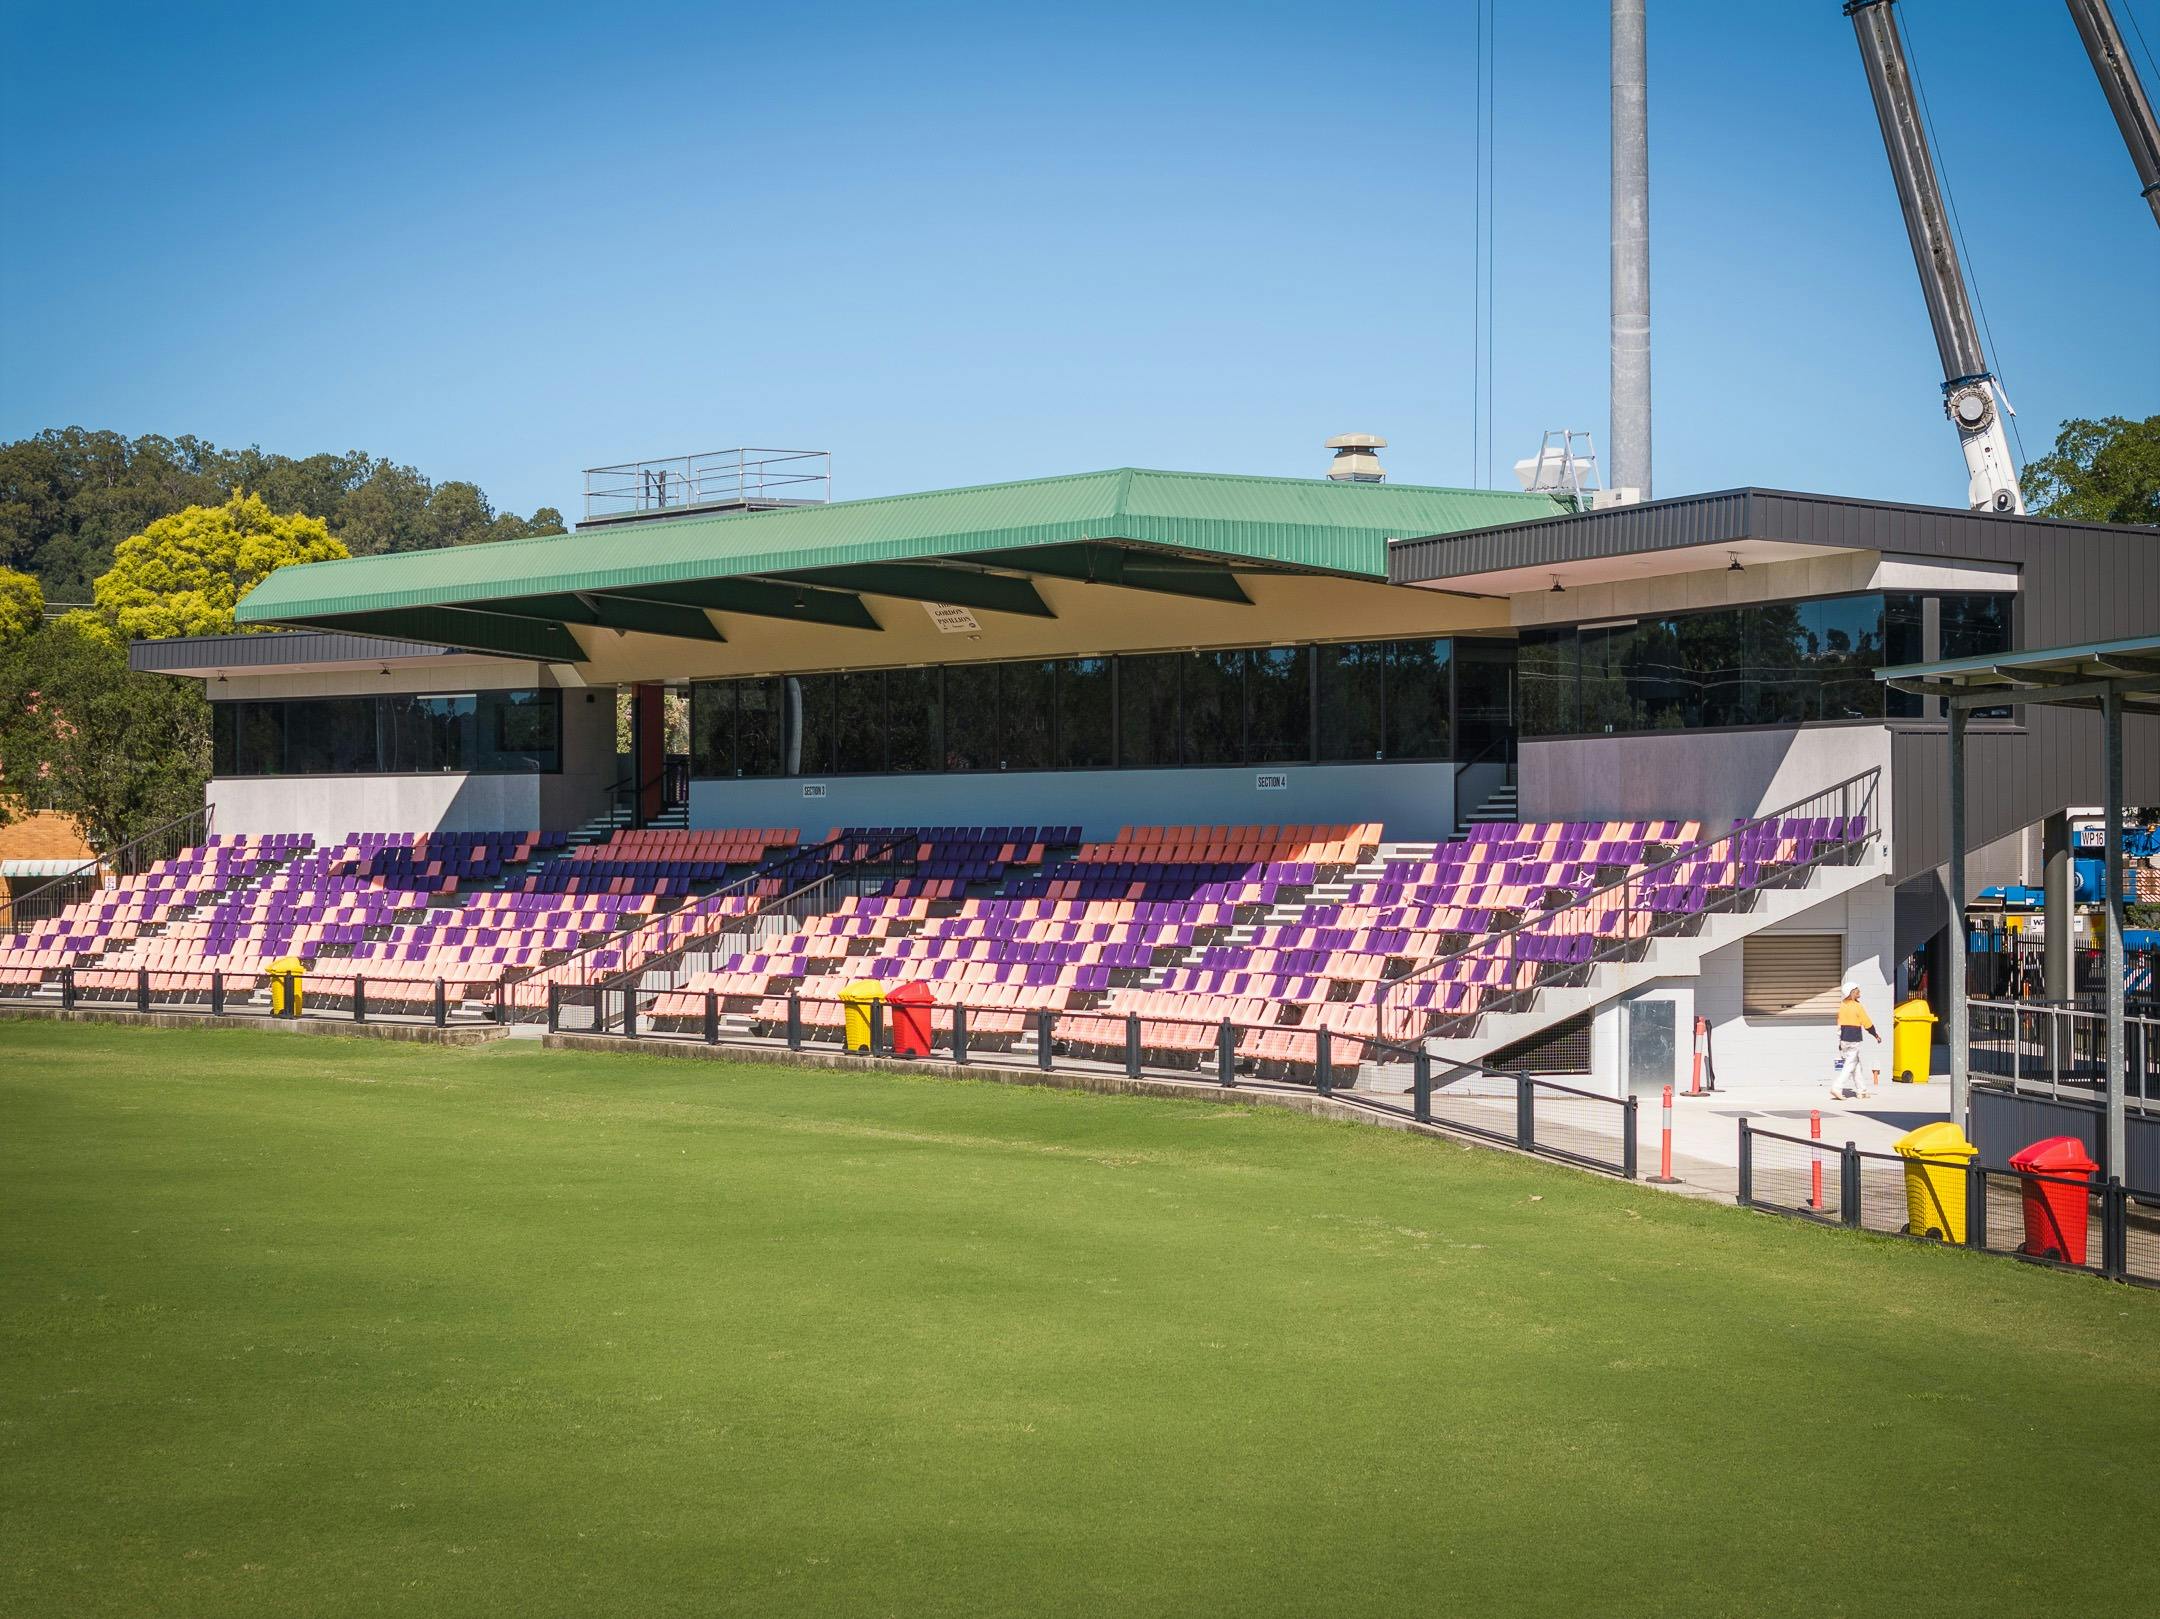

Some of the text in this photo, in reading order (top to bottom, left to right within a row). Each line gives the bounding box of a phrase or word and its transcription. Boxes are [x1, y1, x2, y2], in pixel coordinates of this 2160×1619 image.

[1258, 776, 1280, 787] SECTION
[804, 786, 821, 796] SECTION
[2082, 832, 2104, 846] WP 16
